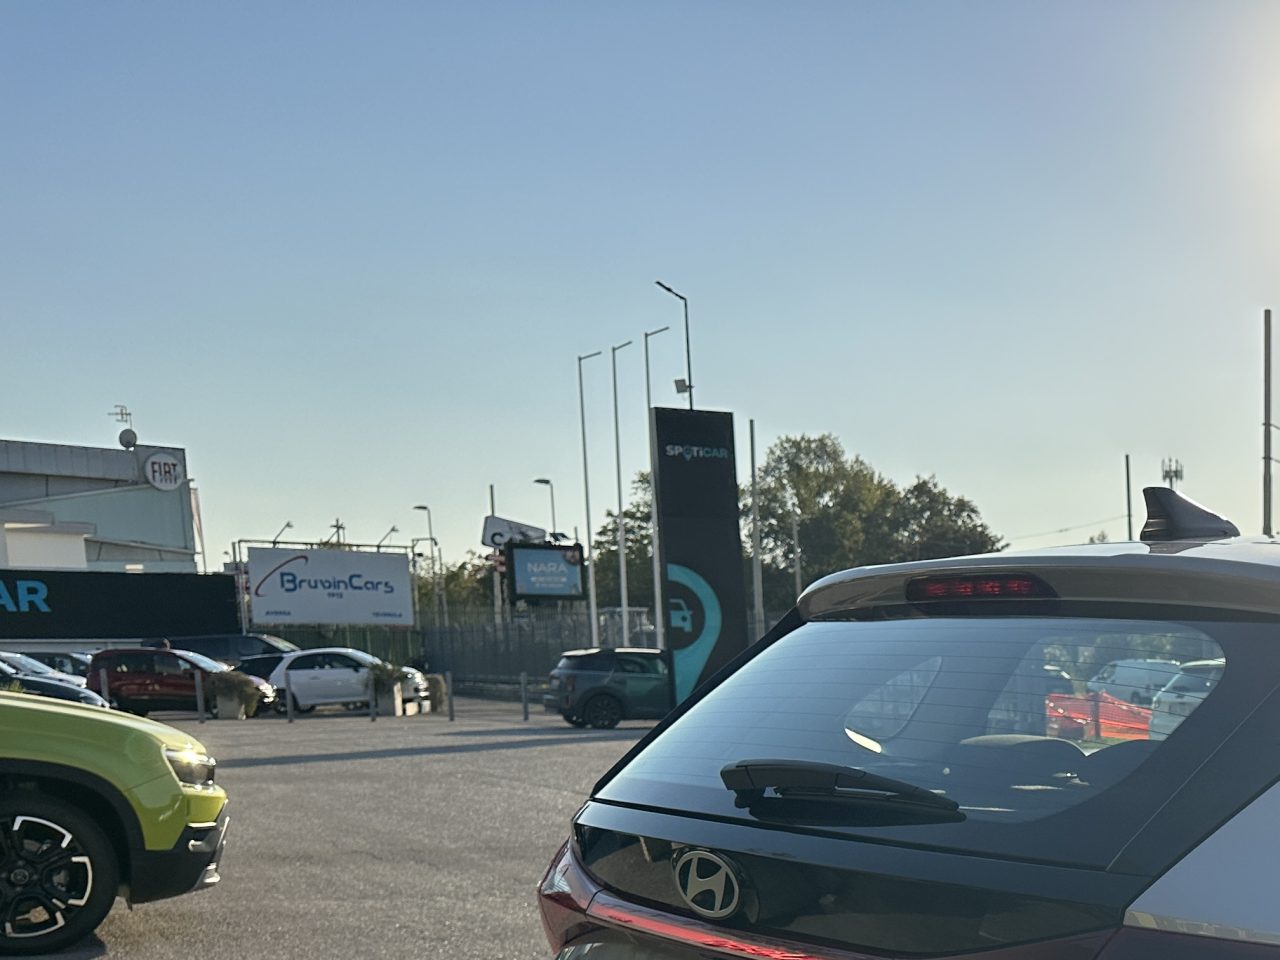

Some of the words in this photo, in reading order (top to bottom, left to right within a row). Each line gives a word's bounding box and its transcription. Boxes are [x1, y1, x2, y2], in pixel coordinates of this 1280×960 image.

[664, 444, 729, 461] SPOTICAR
[151, 461, 177, 484] FIAT
[527, 562, 567, 574] NARA
